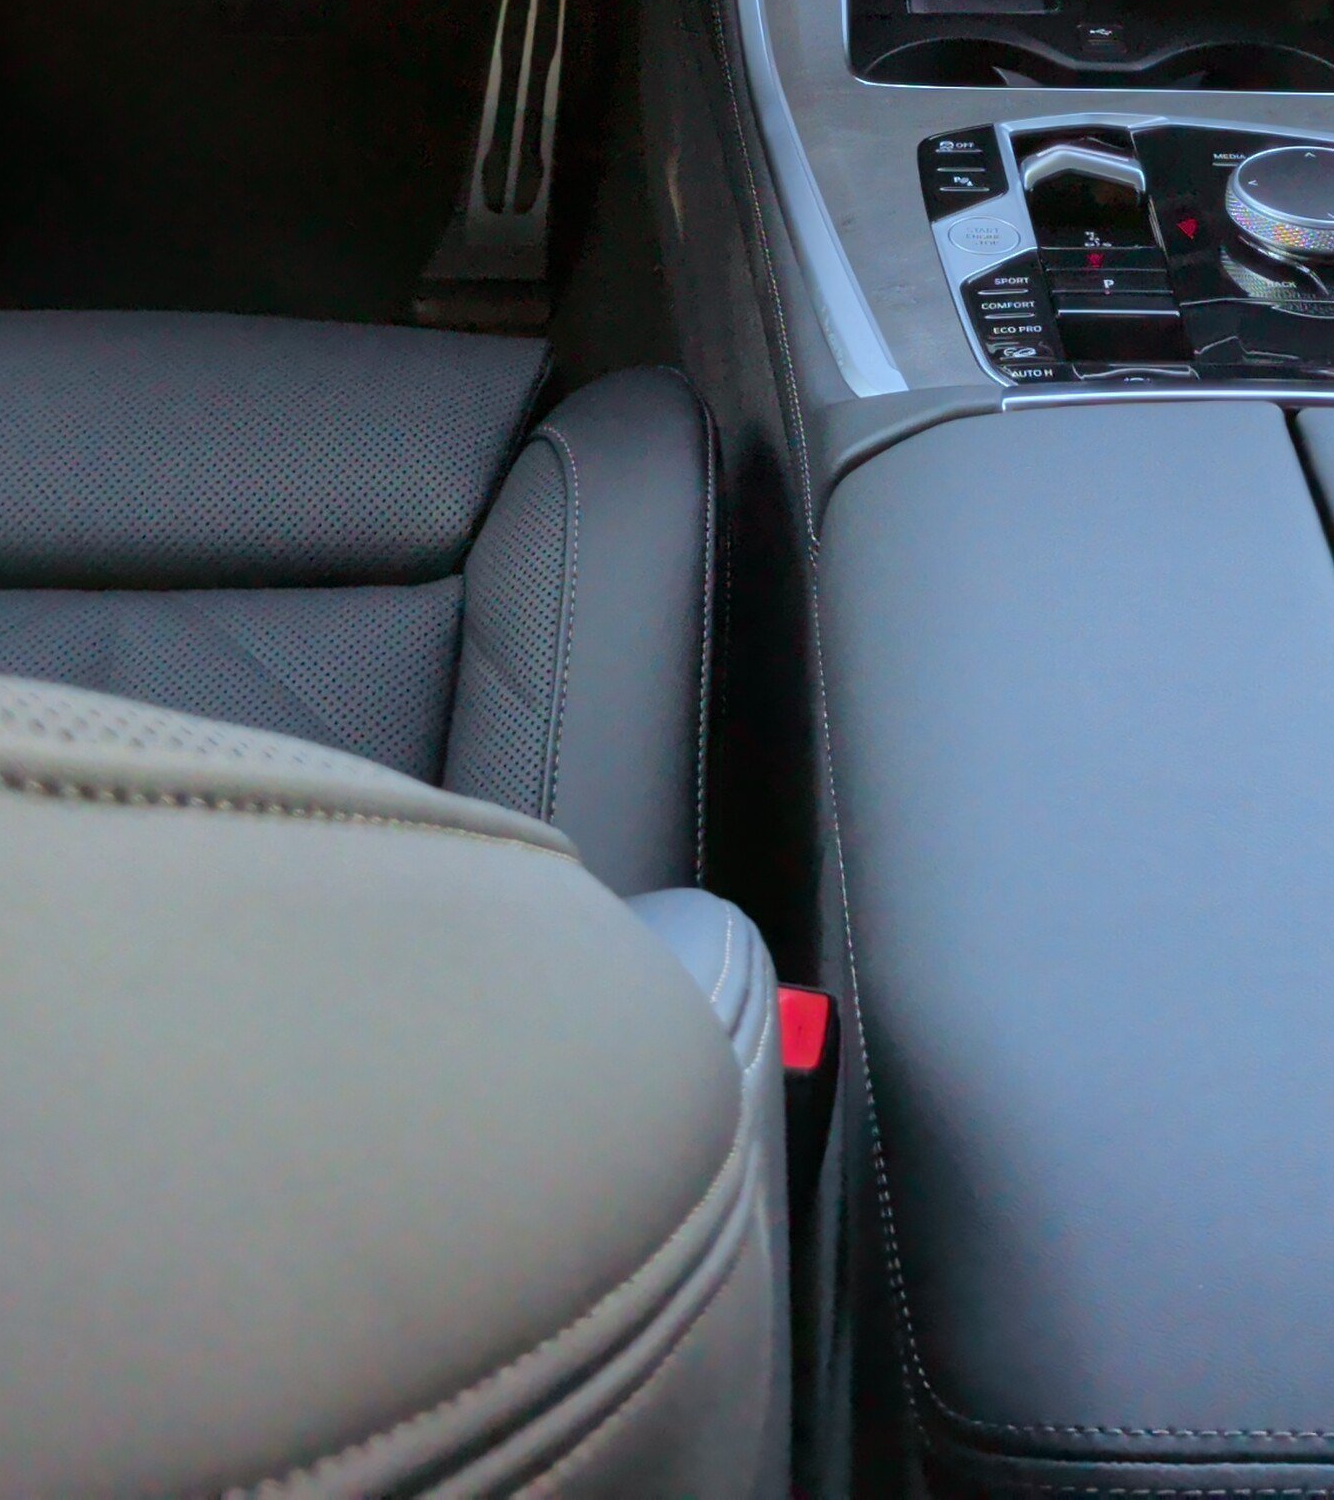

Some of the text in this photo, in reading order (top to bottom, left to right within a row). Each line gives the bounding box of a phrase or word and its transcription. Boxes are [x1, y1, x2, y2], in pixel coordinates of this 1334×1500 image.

[994, 277, 1030, 285] SPORT
[1103, 279, 1115, 289] P
[1267, 281, 1297, 289] BACK
[981, 300, 1035, 310] COMFORT
[993, 325, 1042, 334] ECO PRO
[1011, 369, 1053, 378] AUTO H
